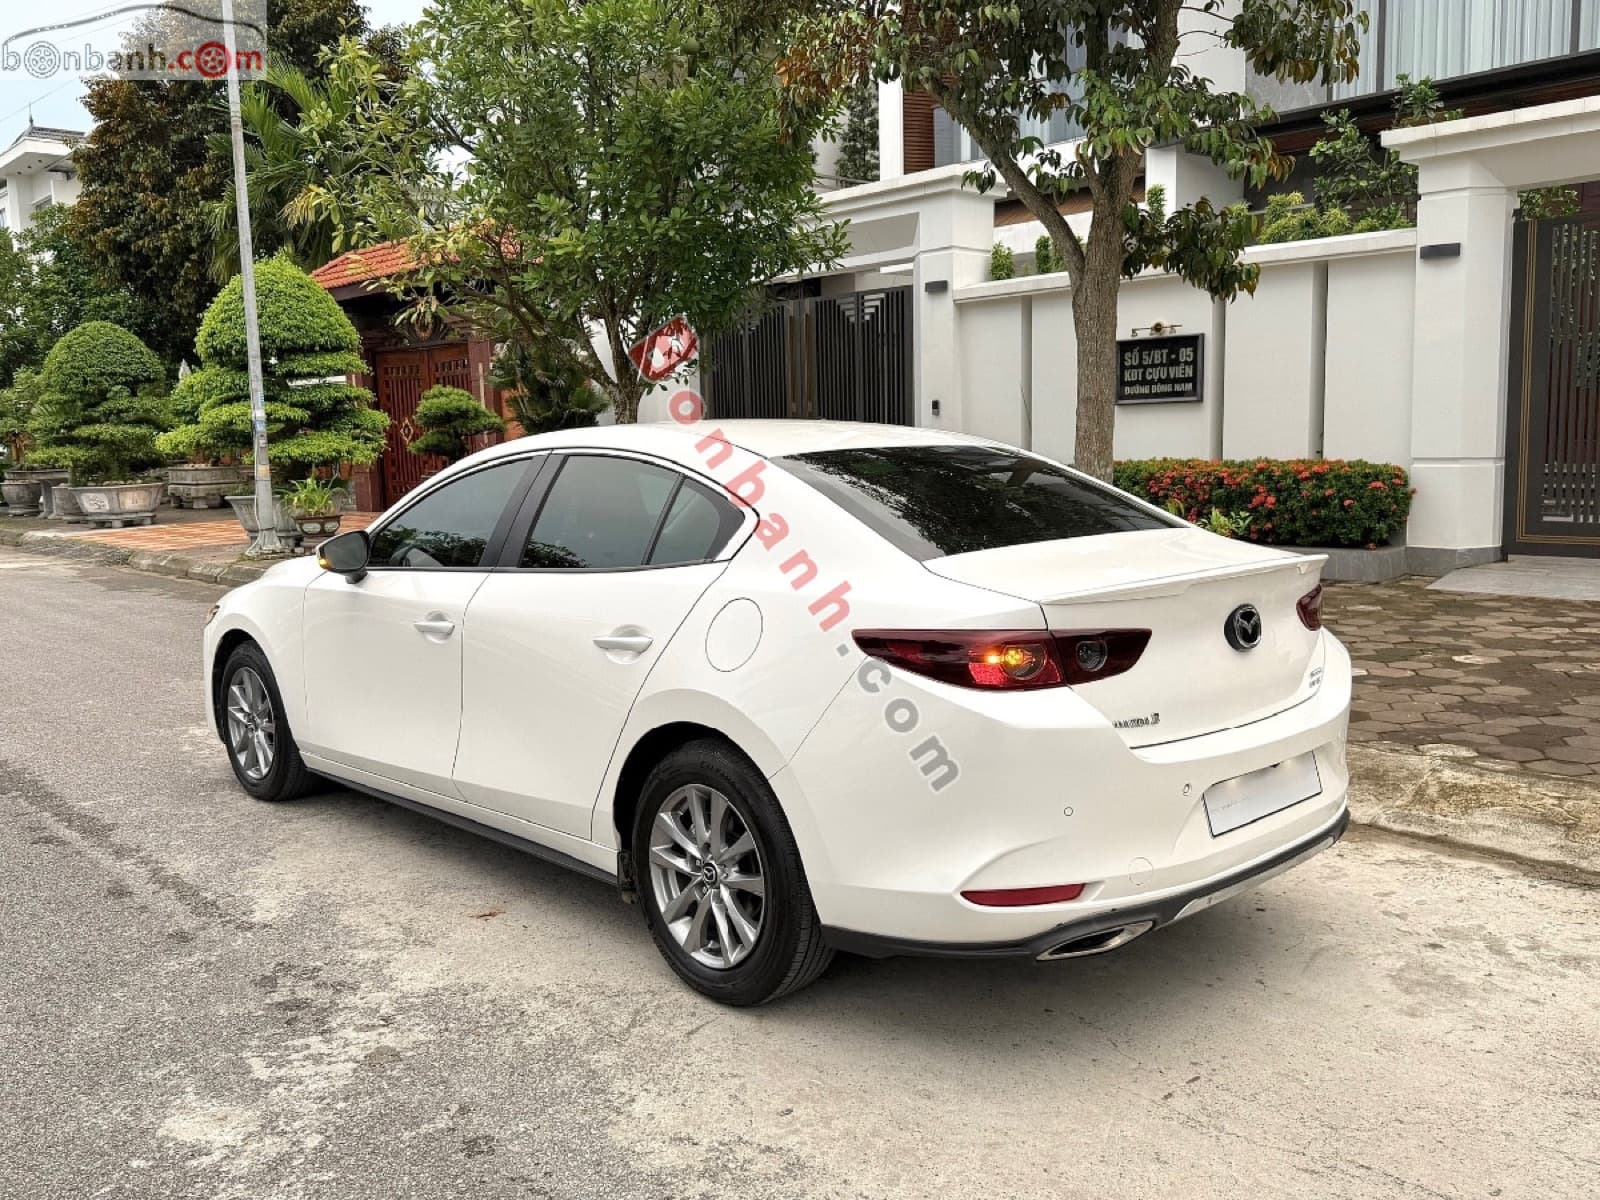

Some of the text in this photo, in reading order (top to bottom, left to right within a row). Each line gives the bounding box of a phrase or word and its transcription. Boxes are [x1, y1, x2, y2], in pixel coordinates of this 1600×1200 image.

[1124, 347, 1140, 366] SỐ
[1142, 349, 1168, 365] 5/BT
[1179, 347, 1194, 362] 05
